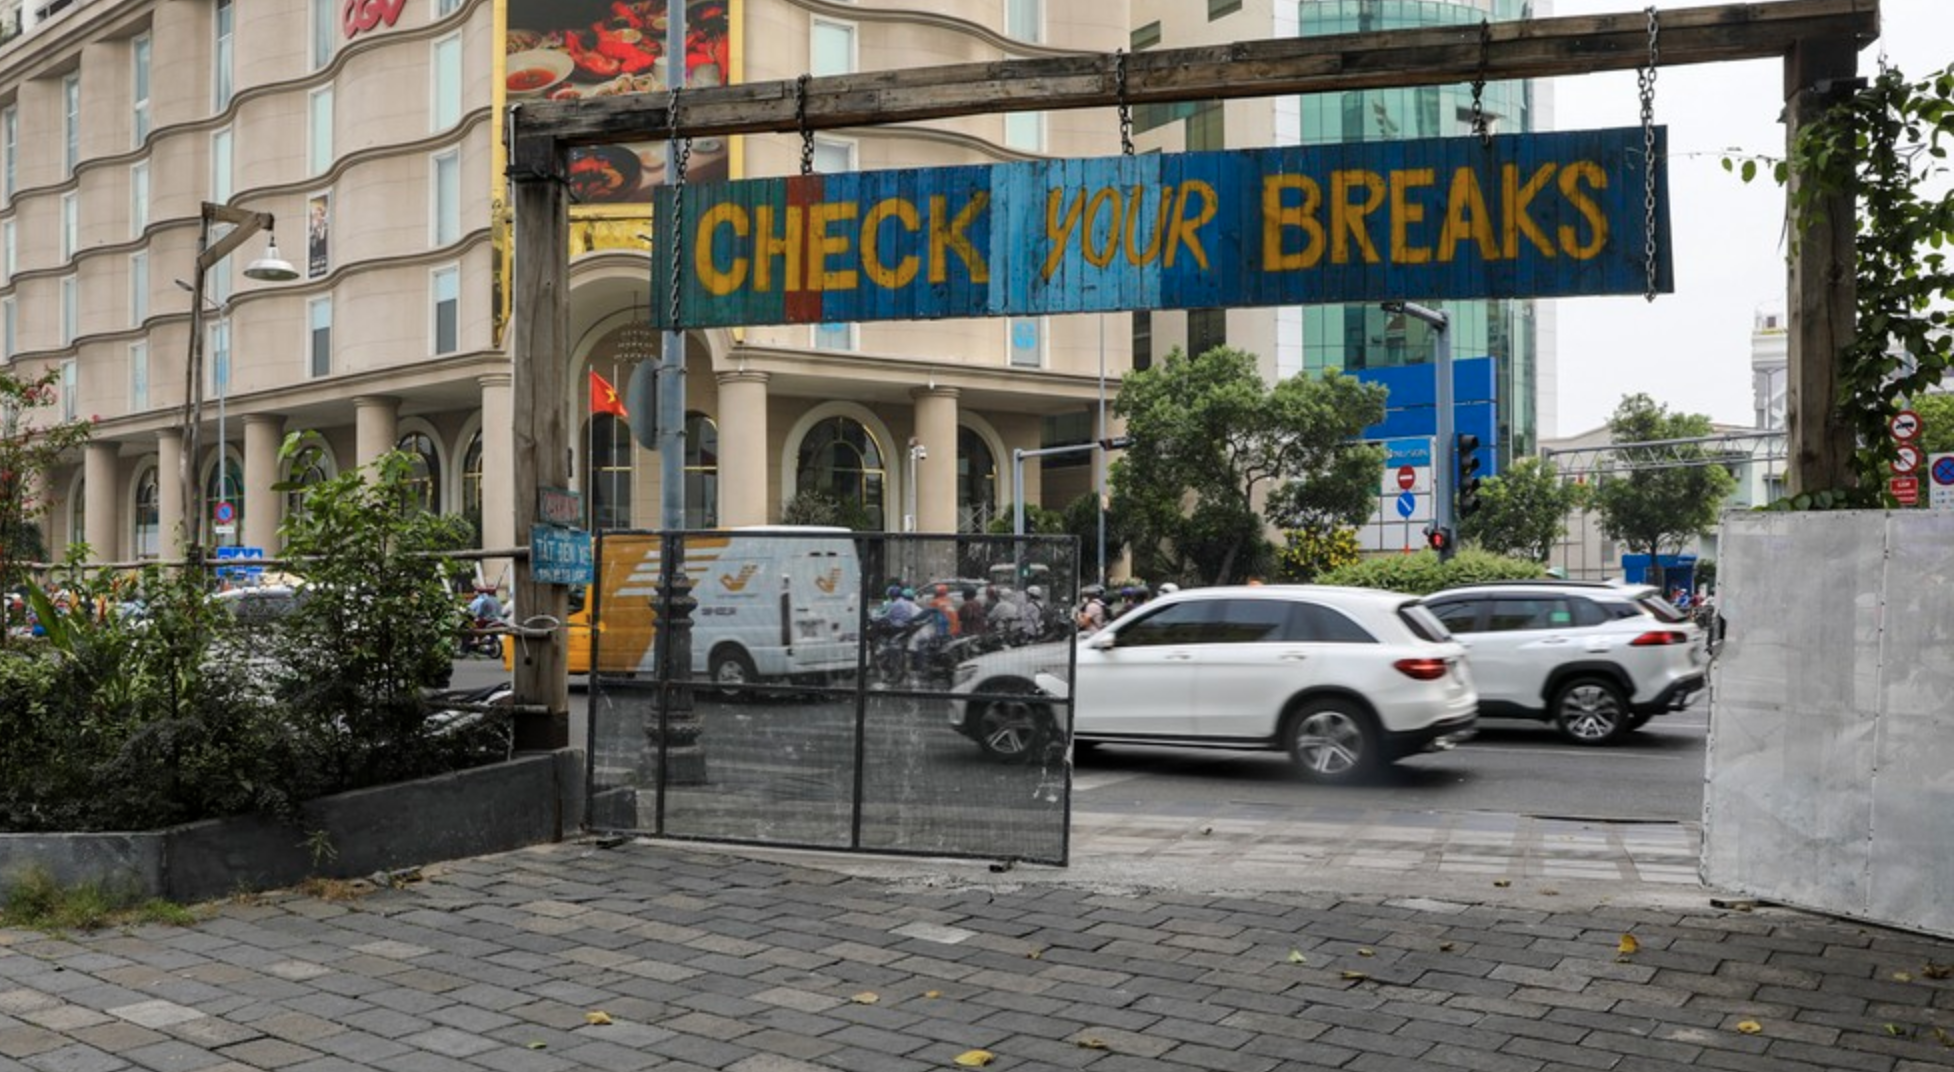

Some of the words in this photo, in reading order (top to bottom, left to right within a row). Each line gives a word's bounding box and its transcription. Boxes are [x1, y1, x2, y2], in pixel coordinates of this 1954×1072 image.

[694, 191, 990, 296] CHECK
[1040, 179, 1219, 283] YOUR
[1262, 160, 1610, 272] BREAKS
